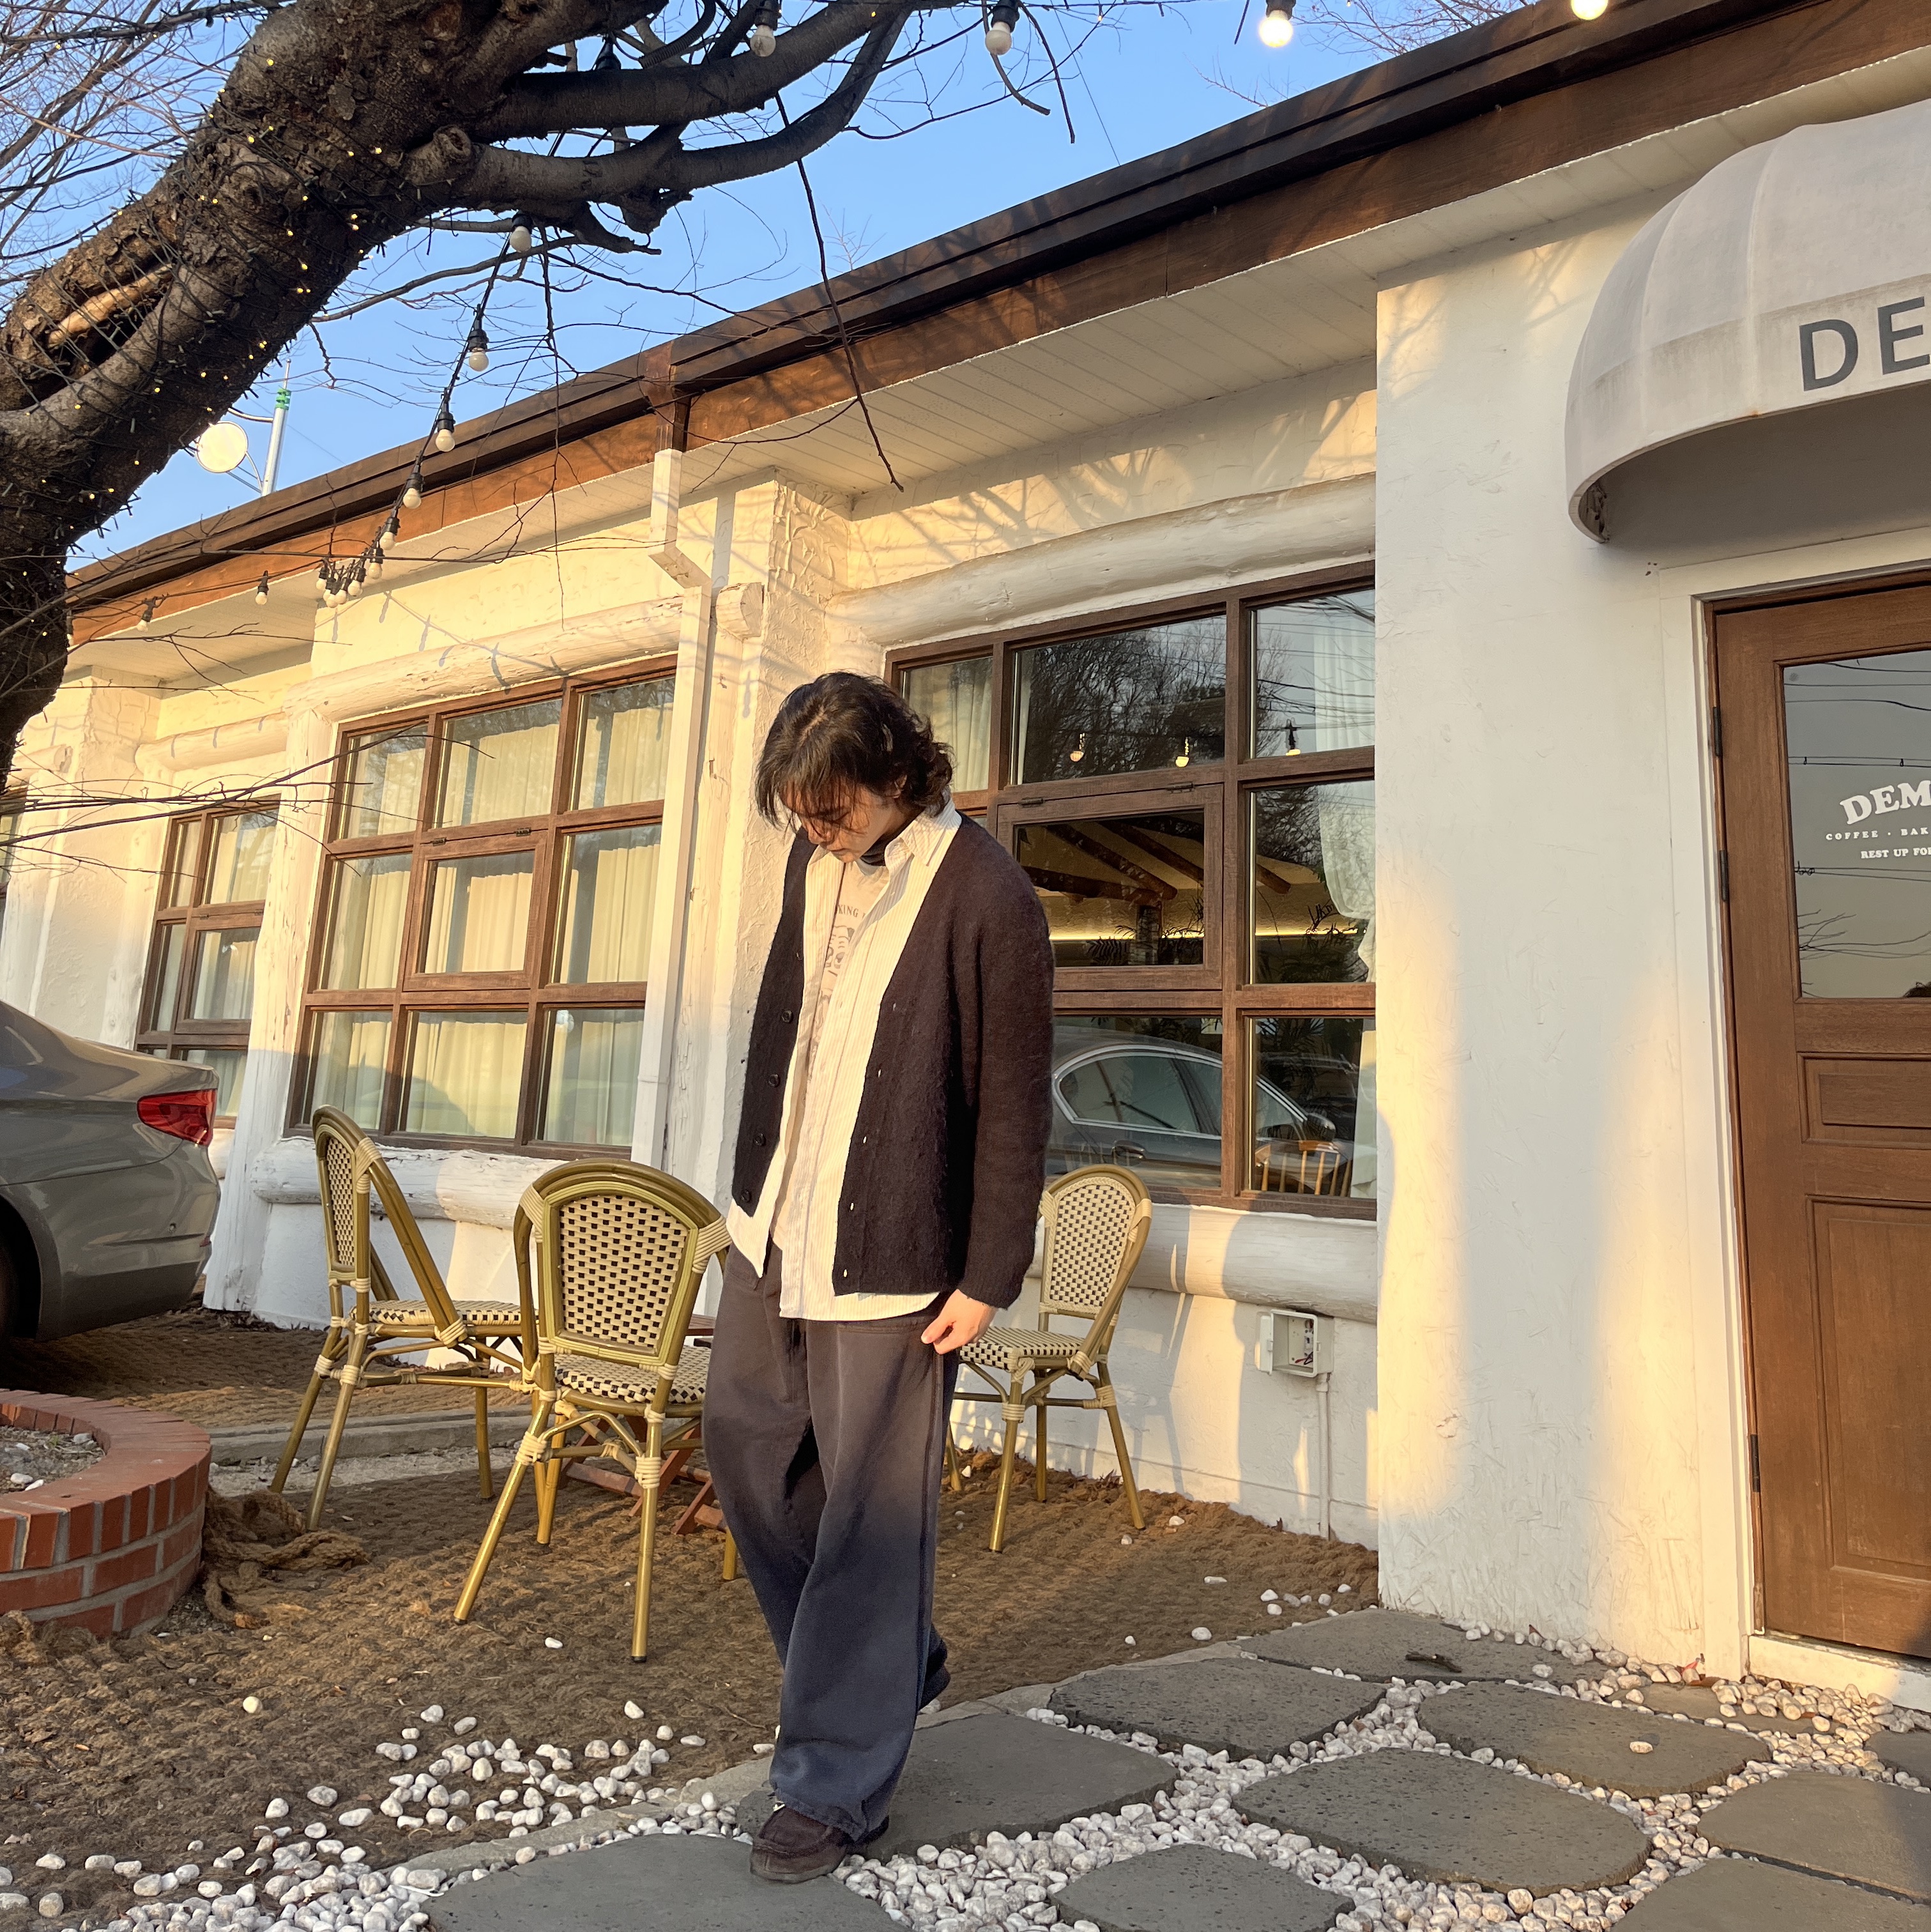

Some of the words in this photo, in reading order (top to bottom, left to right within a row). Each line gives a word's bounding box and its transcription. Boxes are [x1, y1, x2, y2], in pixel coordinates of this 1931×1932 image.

[1799, 296, 1930, 392] DE
[1840, 780, 1931, 825] DEM
[1826, 830, 1879, 841] COFFEE
[1900, 827, 1928, 836] BAK
[1860, 849, 1889, 859] REST
[1893, 848, 1909, 857] UP
[836, 904, 859, 918] KING
